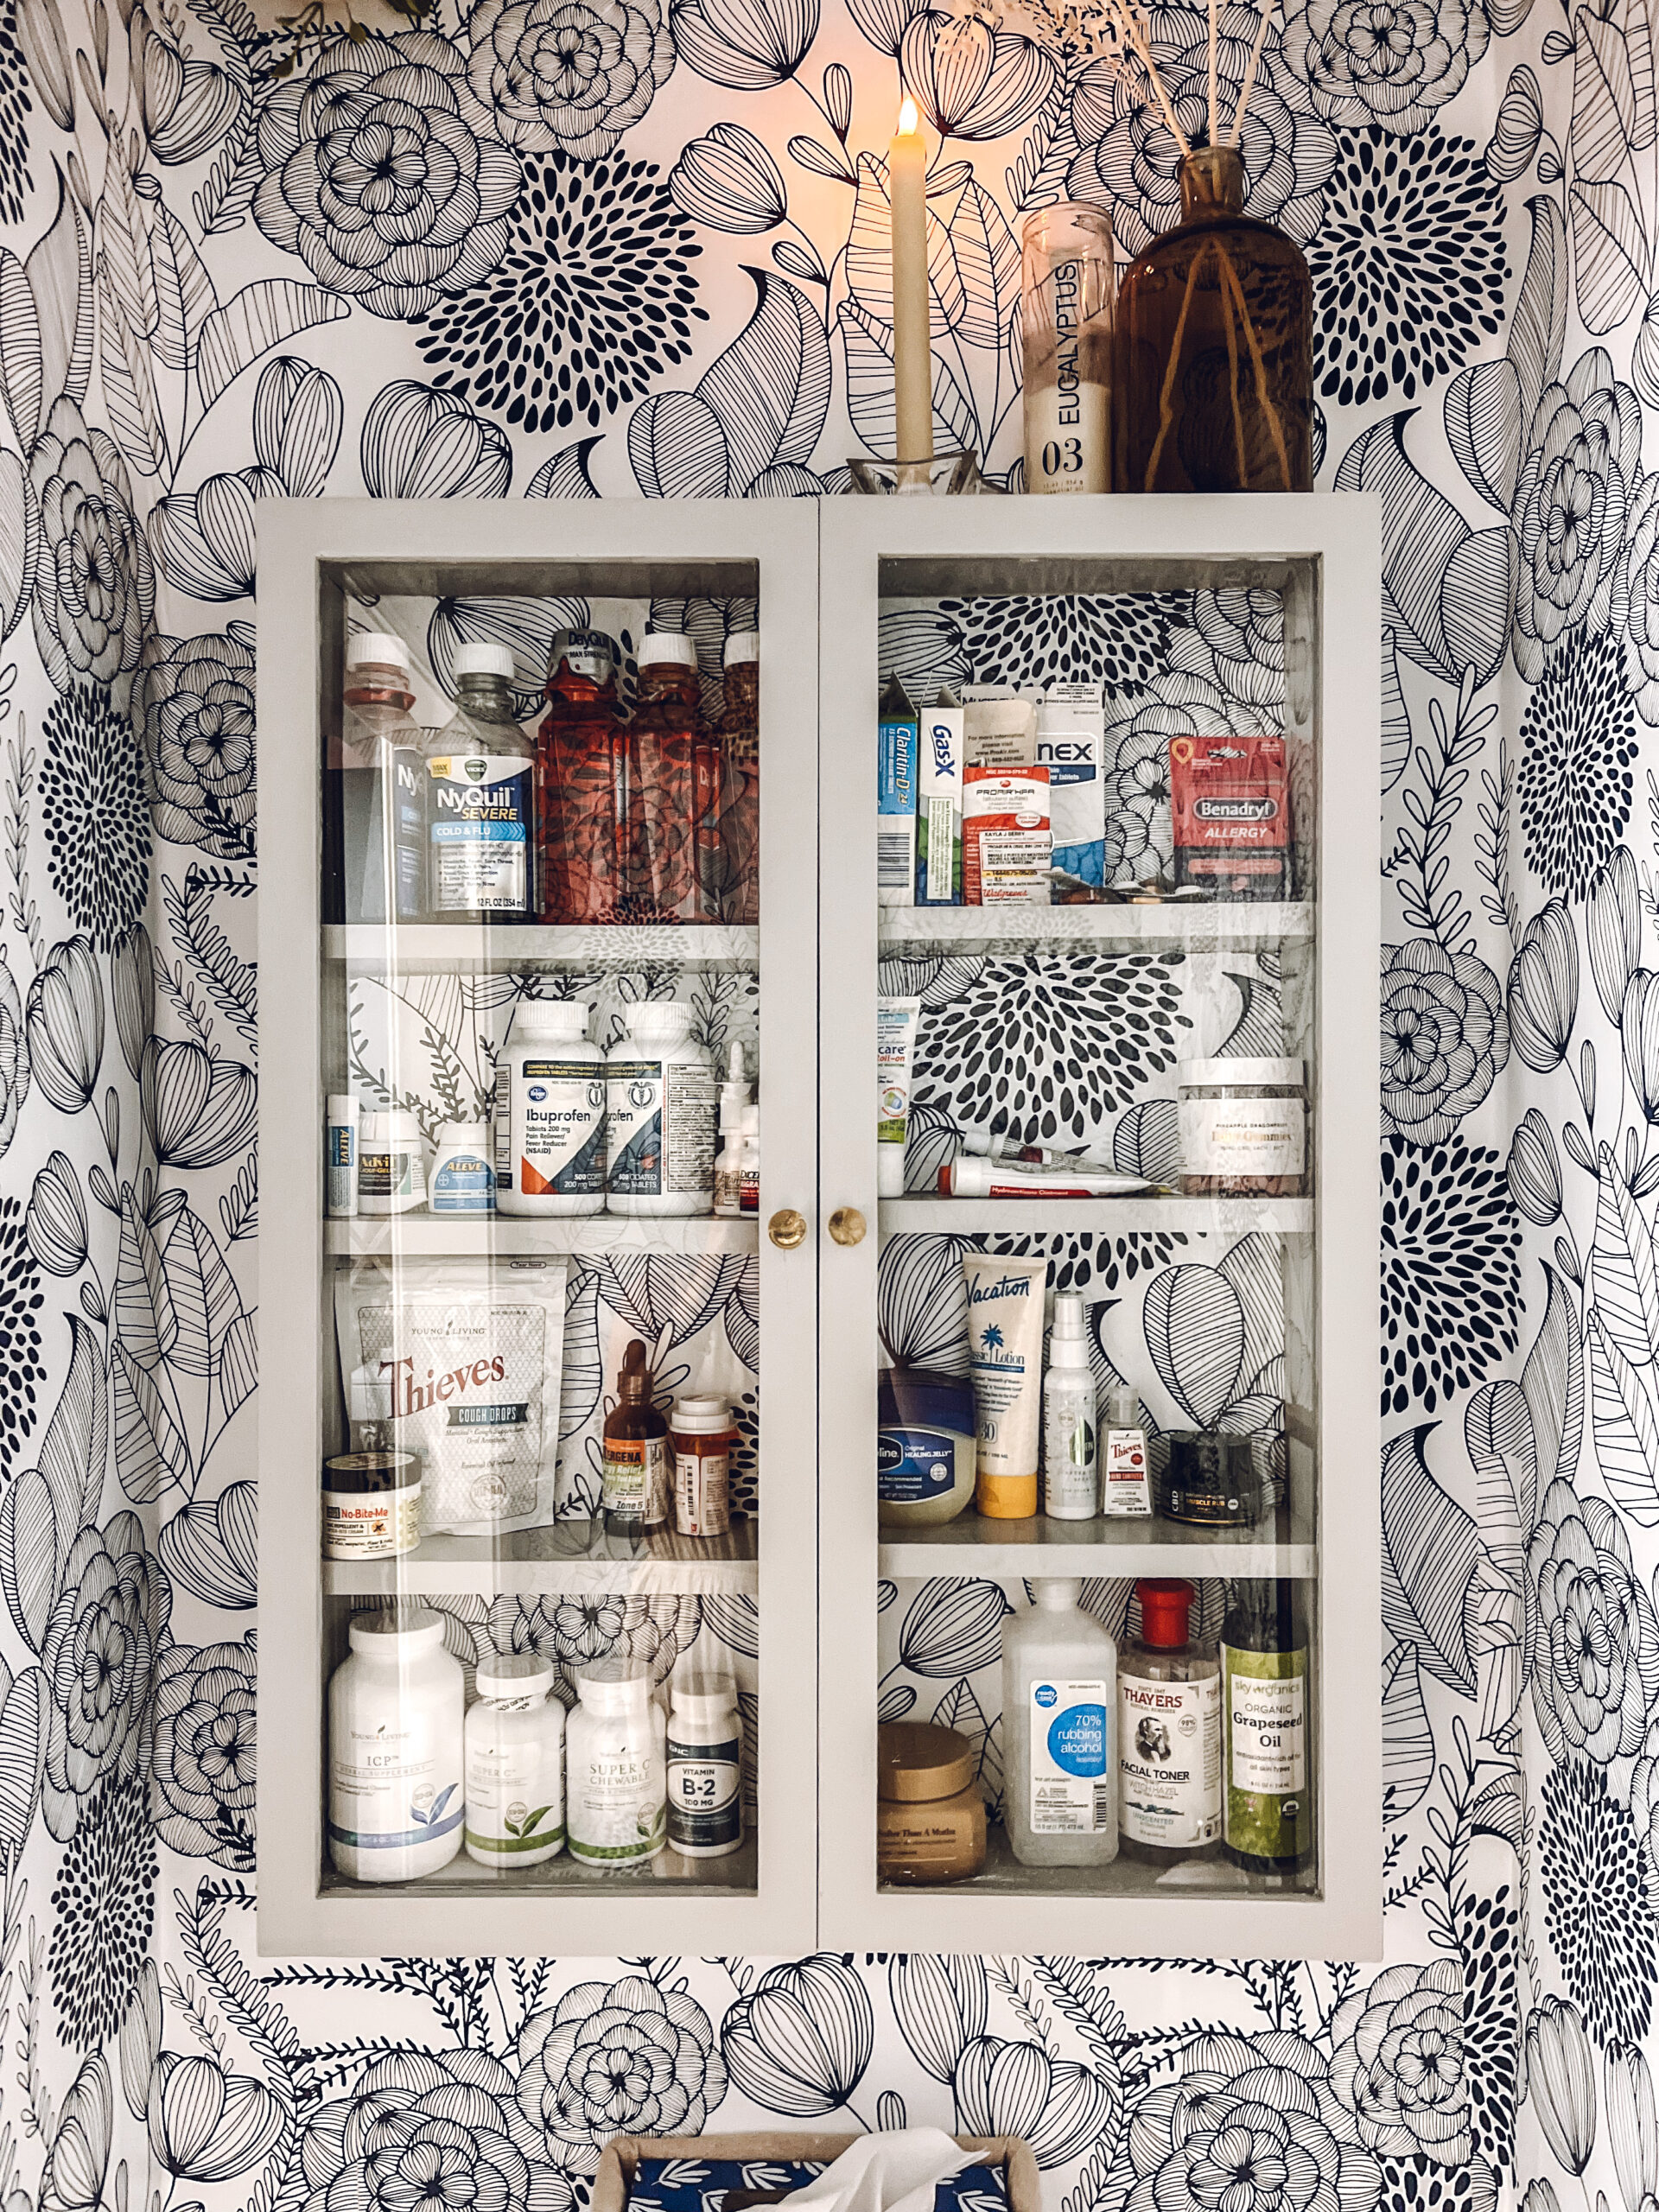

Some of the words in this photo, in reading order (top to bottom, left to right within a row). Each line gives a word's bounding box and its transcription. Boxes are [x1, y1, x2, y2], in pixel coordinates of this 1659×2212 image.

[1055, 264, 1080, 425] EUCALYPTUS
[1042, 437, 1084, 476] 03
[932, 724, 956, 778] Gas-X
[436, 786, 512, 813] NyQuil
[461, 807, 518, 821] SEVERE
[1201, 802, 1269, 819] Benadryl
[435, 827, 462, 836] COLD
[463, 827, 472, 836] &
[473, 827, 491, 836] FLU
[1204, 827, 1268, 838] ALLERGY
[982, 888, 1028, 899] Walgreens
[477, 898, 485, 906] 12
[493, 898, 502, 906] OZ
[503, 898, 516, 907] (354
[526, 1108, 591, 1124] Ibuprofen
[340, 1128, 350, 1165] ALEVE
[361, 1156, 395, 1167] Advil
[446, 1161, 483, 1172] ALEVE
[965, 1273, 1030, 1308] Vacation
[995, 1348, 1025, 1365] Lotion
[378, 1354, 505, 1420] Thieves
[458, 1408, 487, 1423] COUGH
[489, 1407, 517, 1422] DROPS
[878, 1447, 898, 1459] line
[1110, 1443, 1142, 1459] Thieves
[341, 1507, 389, 1519] No-Bite-Me
[616, 1500, 636, 1510] Zone
[637, 1500, 644, 1510] 5
[1235, 1680, 1251, 1695] sky
[1252, 1680, 1300, 1698] organics
[1123, 1687, 1183, 1708] THAYERS
[1244, 1702, 1293, 1714] ORGANIC
[1075, 1714, 1102, 1726] 70%
[1233, 1711, 1303, 1731] Grapeseed
[1058, 1727, 1102, 1743] rubbing
[1259, 1734, 1281, 1747] Oil
[669, 1745, 690, 1757] GNC
[1060, 1741, 1102, 1753] alcohol
[366, 1756, 392, 1767] ICP
[589, 1763, 638, 1776] SUPER
[642, 1758, 651, 1770] C
[682, 1767, 715, 1777] VITAMIN
[1121, 1759, 1152, 1777] FACIAL
[1153, 1769, 1191, 1781] TONER
[682, 1777, 716, 1796] B-2
[1132, 1811, 1174, 1826] UNSCENTED
